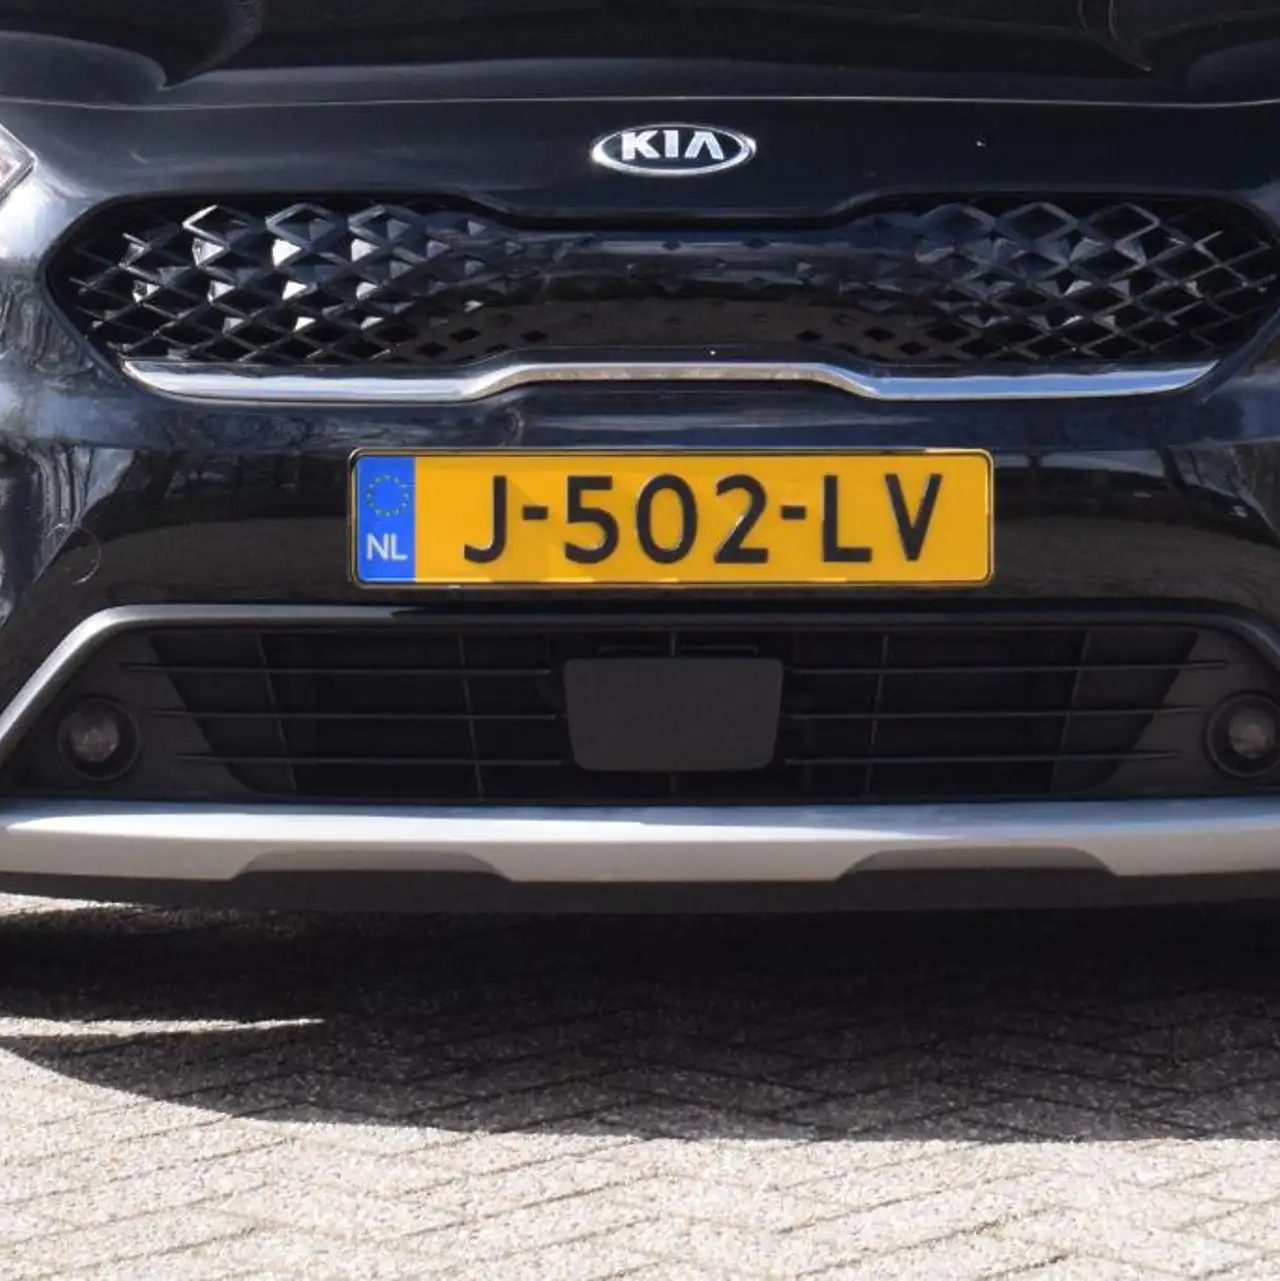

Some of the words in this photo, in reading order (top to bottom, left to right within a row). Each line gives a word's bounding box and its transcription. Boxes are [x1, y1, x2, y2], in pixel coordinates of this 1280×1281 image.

[620, 129, 727, 161] KIA
[463, 474, 943, 565] J-502-LV
[366, 533, 408, 561] NL
